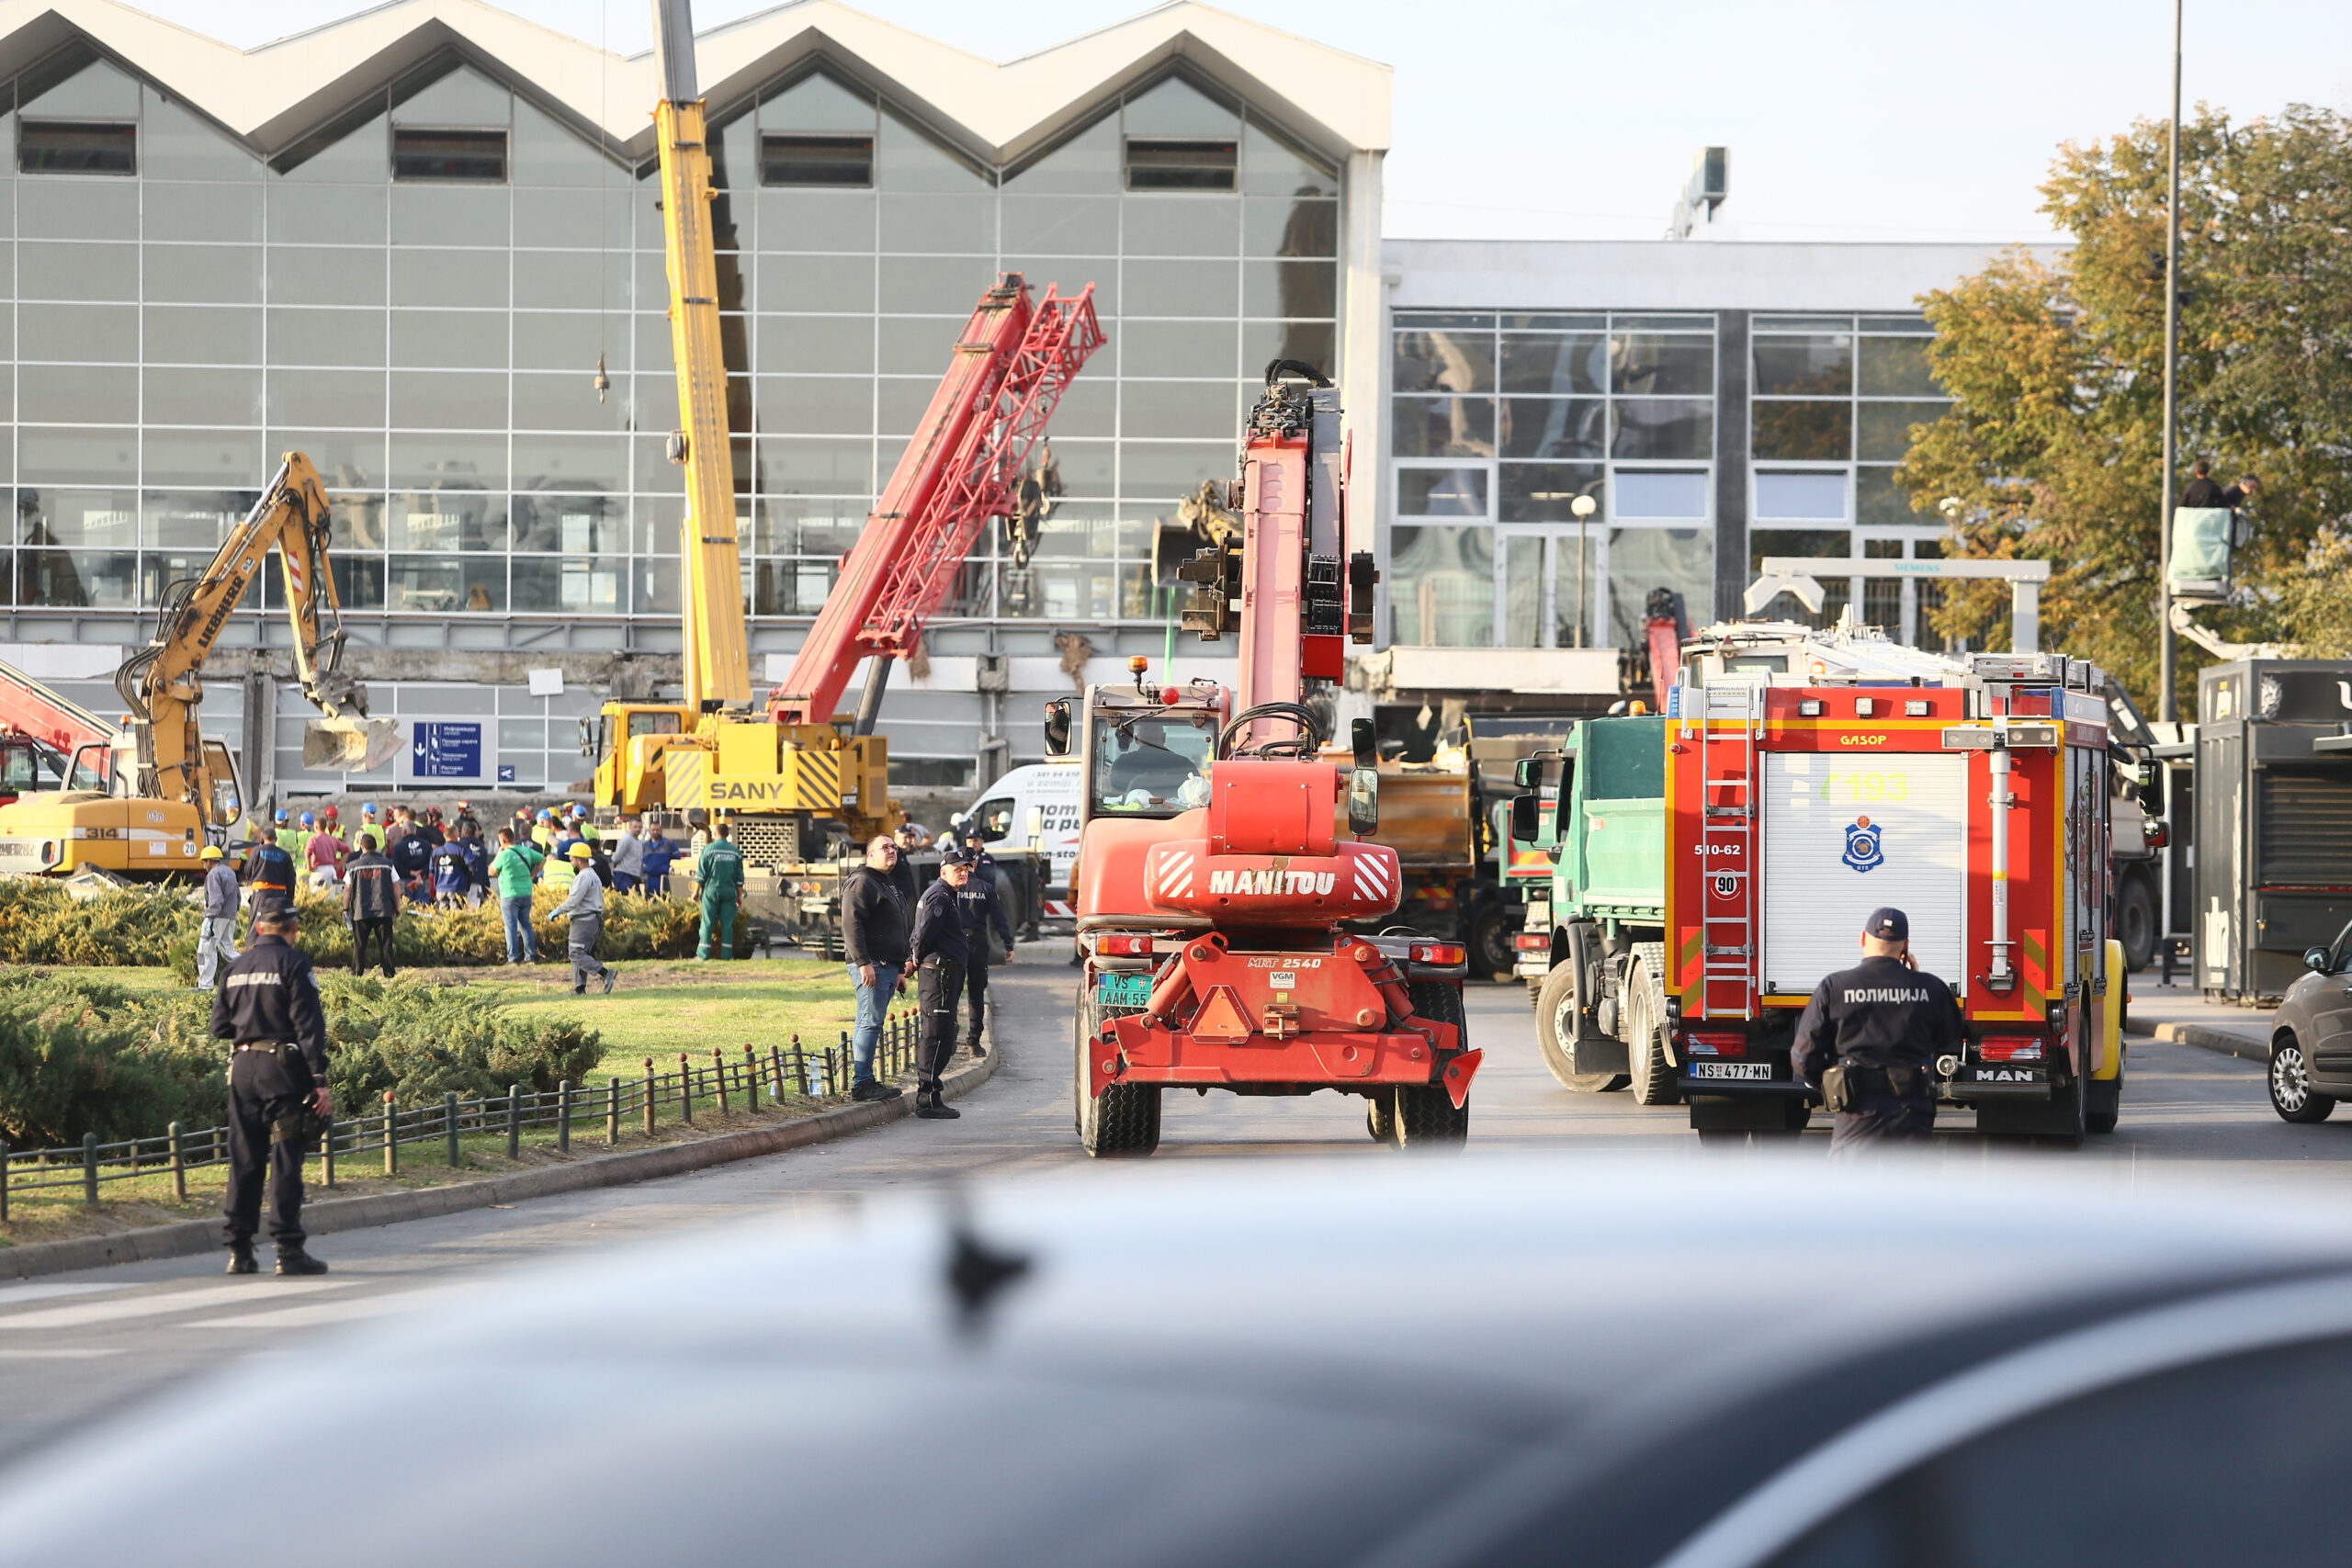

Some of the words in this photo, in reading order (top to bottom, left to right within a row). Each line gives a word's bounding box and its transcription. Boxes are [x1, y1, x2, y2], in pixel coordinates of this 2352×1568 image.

[197, 576, 245, 648] LIEBHERR
[1839, 735, 1887, 745] GASOP
[710, 782, 784, 800] SANY
[1844, 772, 1909, 801] 193
[86, 828, 119, 839] 314
[185, 843, 196, 854] 20
[1694, 844, 1741, 855] 510-62
[1209, 870, 1336, 896] MANITOU
[1718, 876, 1735, 892] 90
[1247, 957, 1279, 968] MRT
[1283, 958, 1322, 969] 2540
[1114, 975, 1128, 989] VS
[1843, 987, 1929, 1005] ПОЛИЦИЈА
[1698, 1064, 1714, 1077] NS
[1976, 1069, 2033, 1082] MAN
